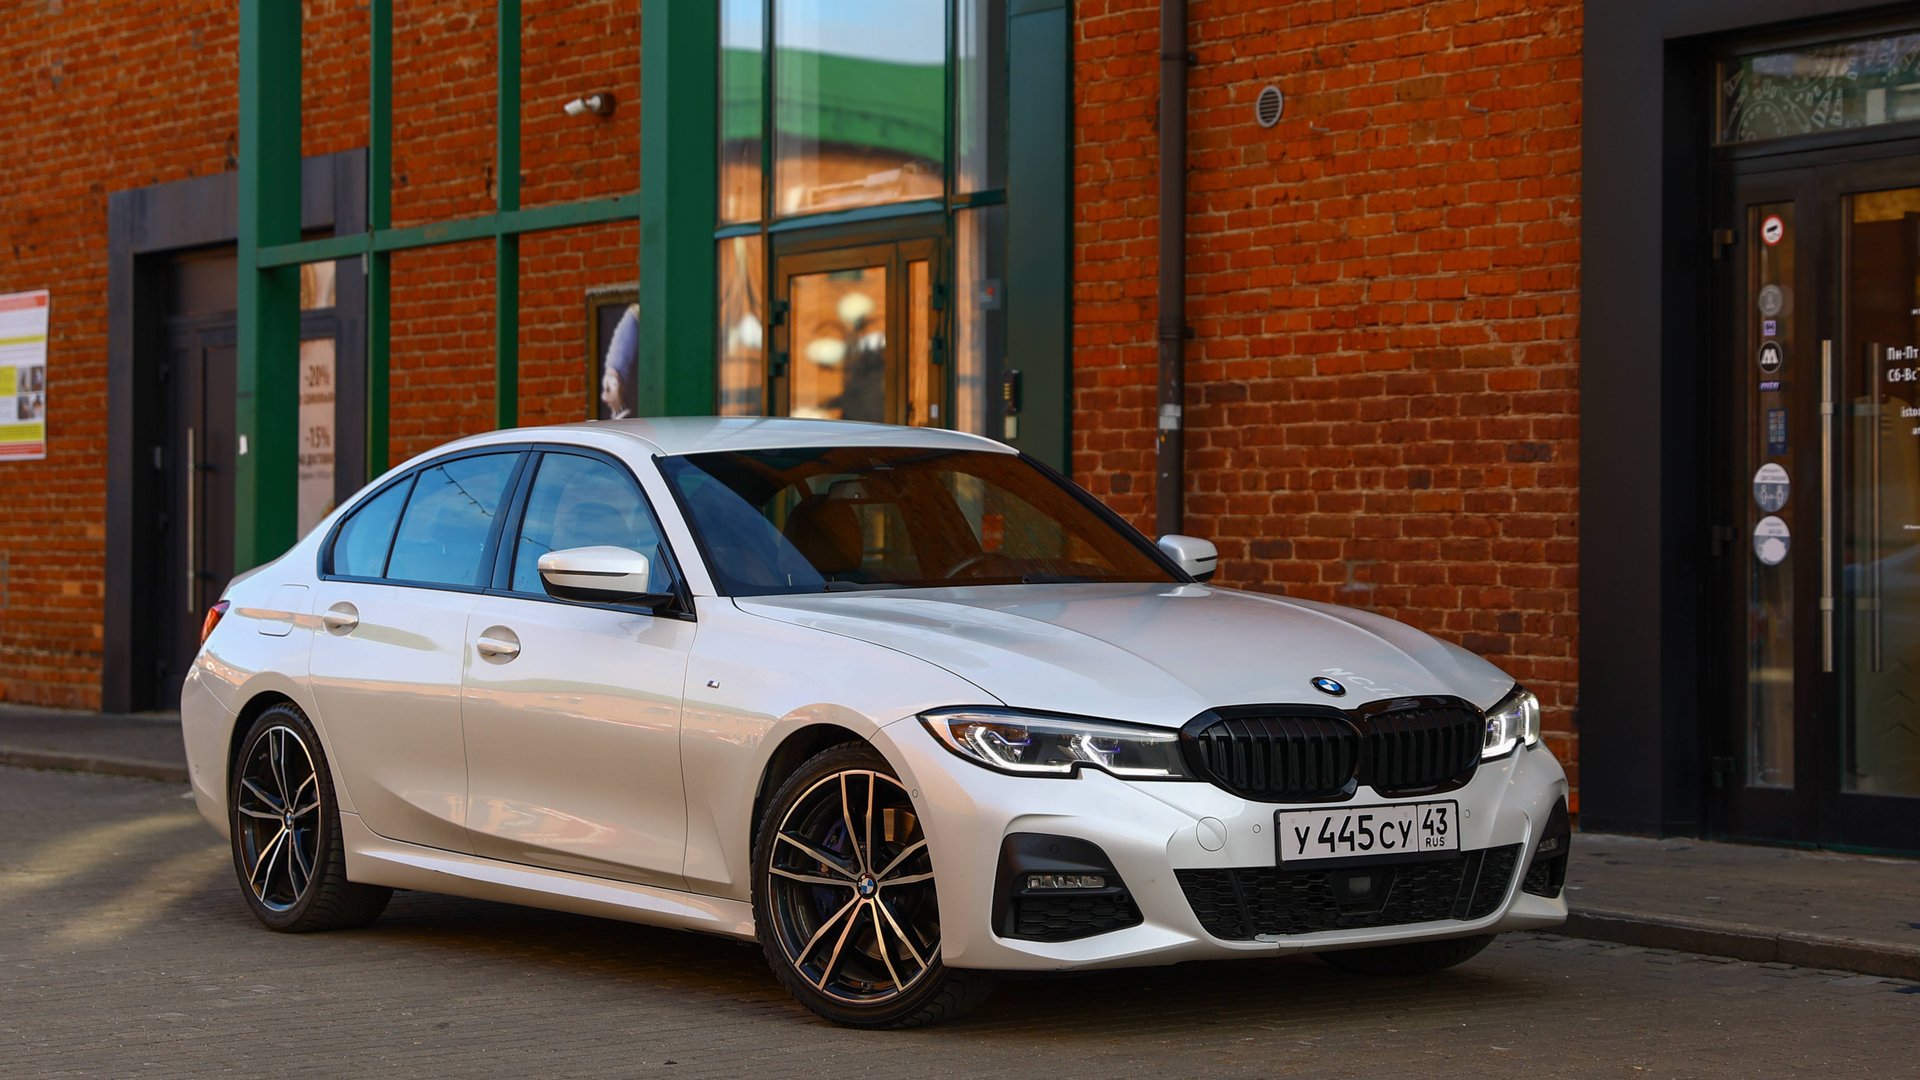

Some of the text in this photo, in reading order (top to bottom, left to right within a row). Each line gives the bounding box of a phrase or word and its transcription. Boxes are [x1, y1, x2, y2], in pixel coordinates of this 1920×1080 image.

[1887, 346, 1919, 361] Пн-Пт
[304, 364, 331, 388] -20%
[1887, 367, 1917, 382] Сб-Вс
[304, 425, 331, 448] -15%
[1422, 807, 1448, 836] 43
[1425, 836, 1445, 848] RUS
